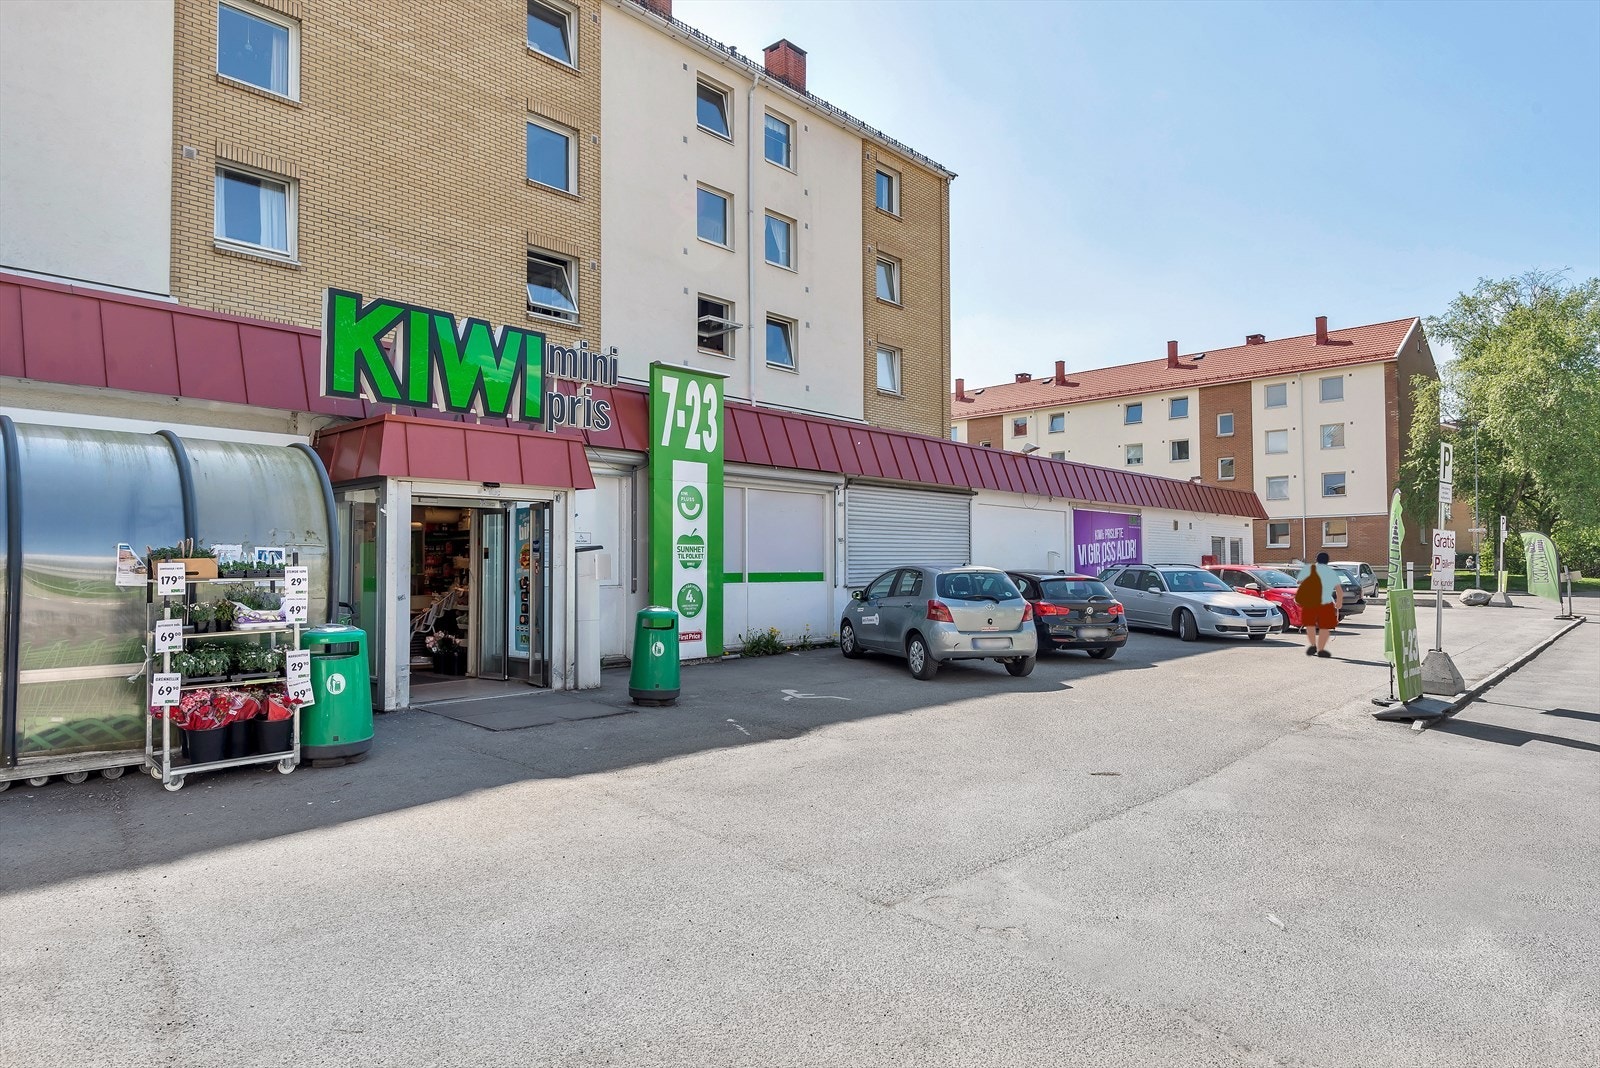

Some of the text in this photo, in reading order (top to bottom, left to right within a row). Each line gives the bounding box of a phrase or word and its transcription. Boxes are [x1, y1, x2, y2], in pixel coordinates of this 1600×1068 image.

[322, 288, 545, 424] KIWI
[546, 340, 618, 386] mini
[546, 388, 611, 432] pris
[661, 375, 718, 453] 7-23
[1443, 446, 1451, 479] P
[1434, 533, 1455, 549] Gratis
[1077, 539, 1137, 566] VI GIR OSS ALDRI
[1434, 556, 1441, 570] P
[161, 575, 178, 585] 179
[290, 577, 302, 586] 29
[685, 589, 696, 603] 4.
[289, 605, 301, 615] 49
[160, 632, 175, 642] 69
[689, 632, 701, 640] Price
[291, 661, 303, 671] 29
[157, 686, 172, 696] 69
[293, 689, 306, 699] 99
